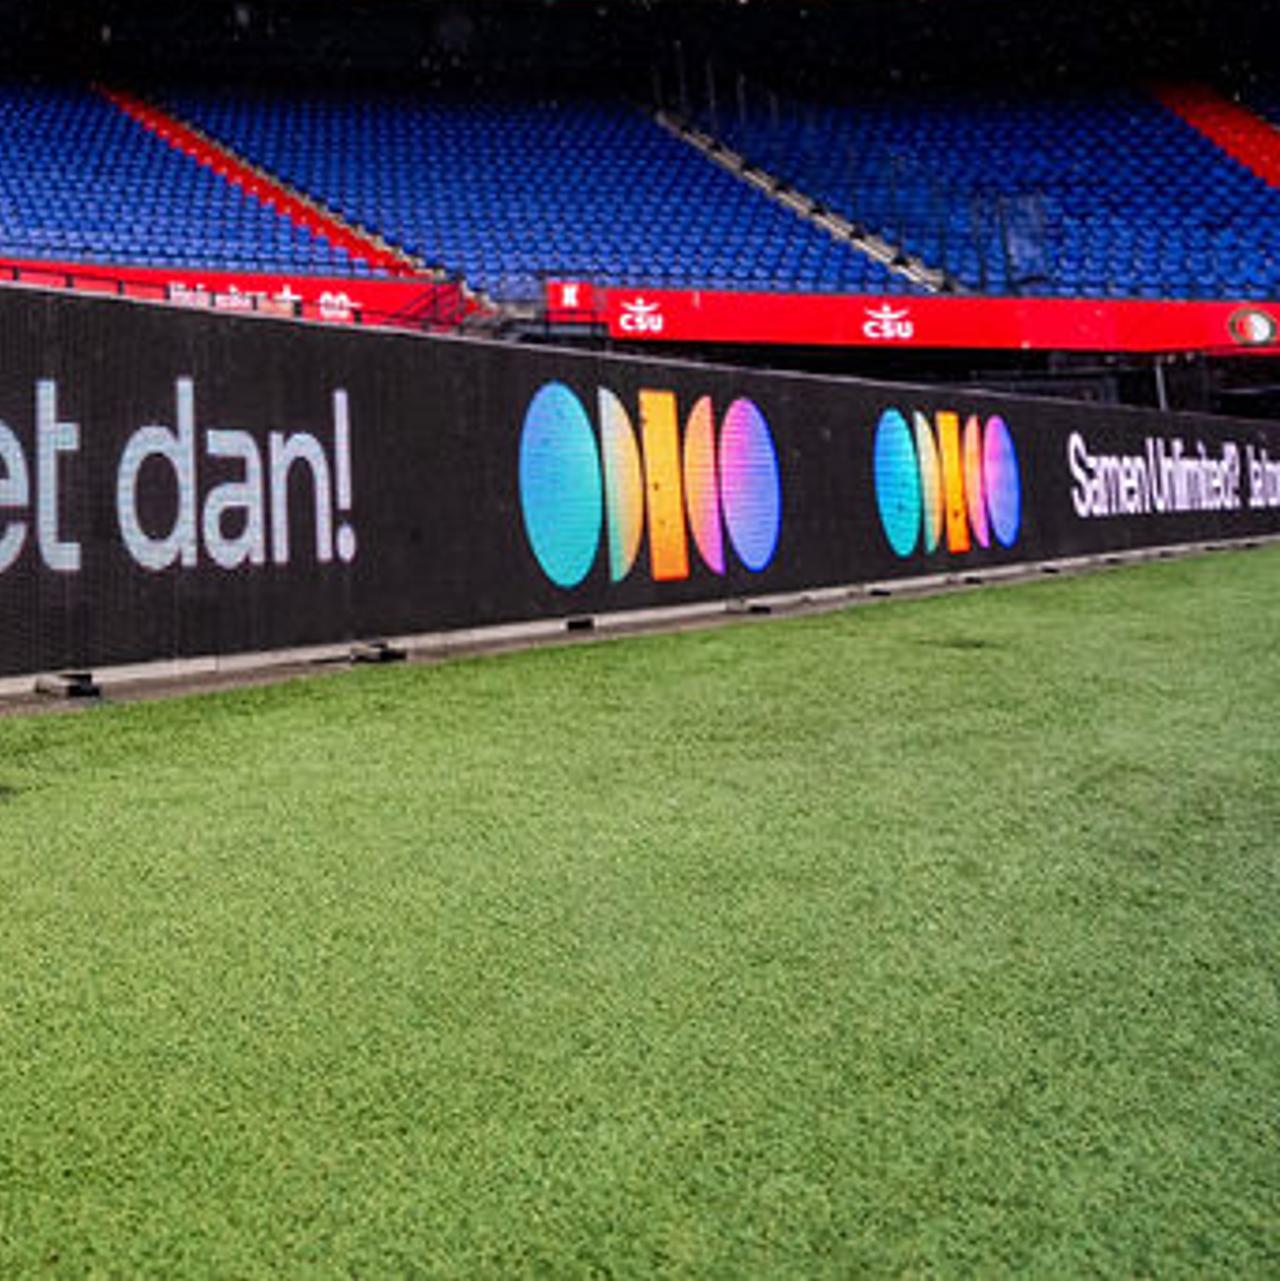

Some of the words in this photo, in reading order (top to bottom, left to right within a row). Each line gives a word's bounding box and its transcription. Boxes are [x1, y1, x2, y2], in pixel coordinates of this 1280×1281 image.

[620, 310, 663, 333] CSU
[863, 317, 915, 339] CSU
[116, 376, 357, 570] dan!
[1069, 431, 1151, 518] Samen
